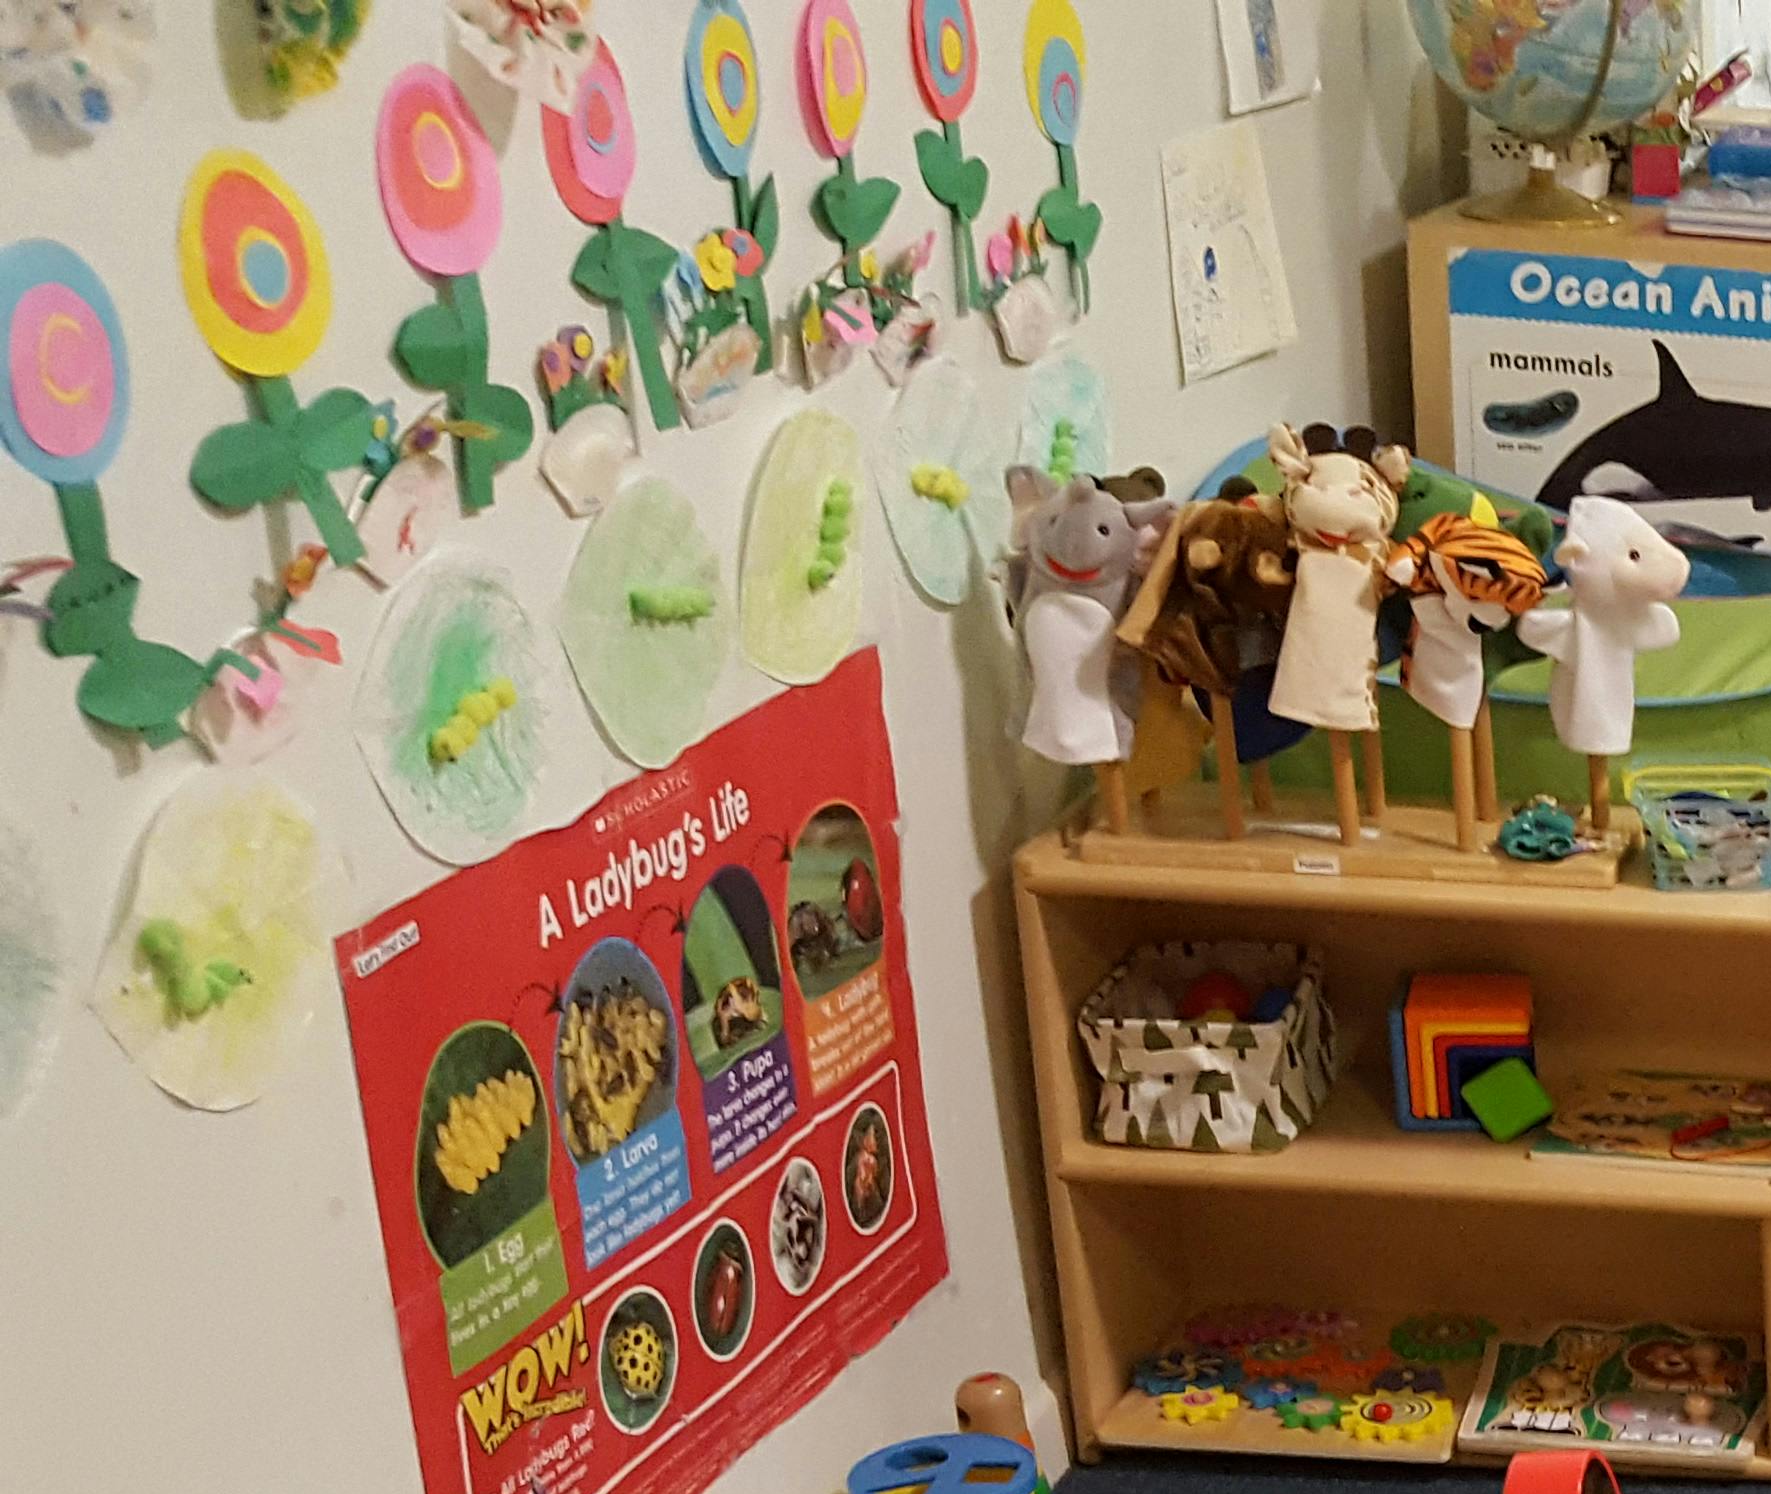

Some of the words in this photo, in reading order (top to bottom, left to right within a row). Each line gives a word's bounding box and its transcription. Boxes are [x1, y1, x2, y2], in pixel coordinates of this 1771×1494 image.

[1509, 261, 1674, 316] Ocean
[1488, 349, 1615, 379] mammals
[606, 773, 692, 830] SCHOLASTIC
[538, 892, 564, 949] A
[566, 812, 706, 928] Ladybug's
[710, 780, 751, 843] Life
[727, 1071, 740, 1093] 3.
[741, 1050, 774, 1082] Pupa
[603, 1159, 620, 1181] 2.
[620, 1133, 659, 1169] Larva
[483, 1253, 496, 1274] 1.
[496, 1231, 524, 1265] Egg
[459, 1300, 590, 1447] WOW!
[518, 1435, 571, 1487] Ladybugs
